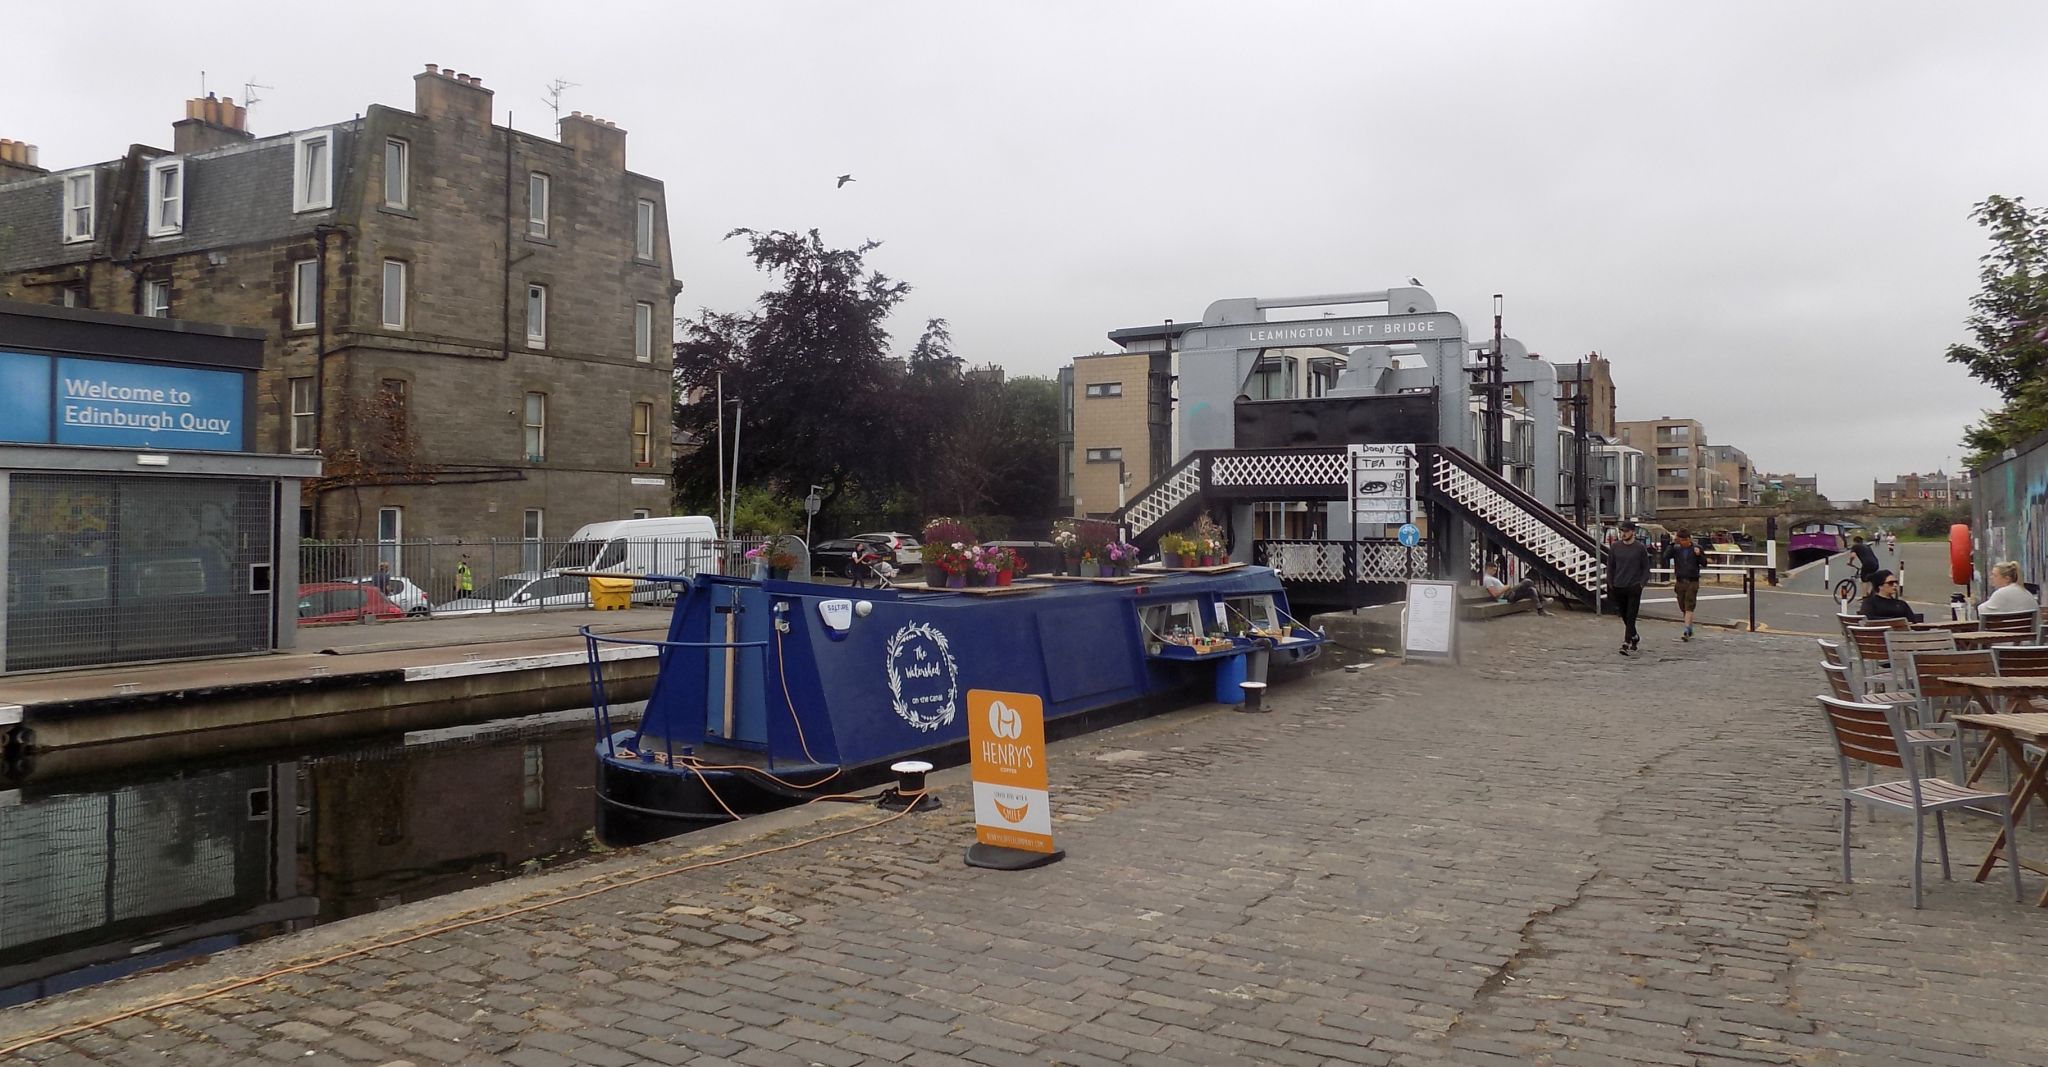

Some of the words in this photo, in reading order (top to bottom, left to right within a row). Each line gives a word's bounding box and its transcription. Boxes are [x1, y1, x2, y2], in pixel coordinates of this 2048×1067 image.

[1249, 327, 1333, 341] LEAMINGTON
[1343, 324, 1374, 336] LIFT
[1384, 321, 1435, 334] BRIDGE
[65, 378, 164, 403] Welcome
[169, 388, 191, 404] to
[65, 405, 173, 431] Edinburgh
[179, 412, 231, 435] Quay
[1362, 459, 1385, 468] TEA
[913, 645, 928, 660] The
[905, 662, 940, 679] Watershed
[982, 740, 1033, 768] HENRY'S
[1002, 808, 1021, 823] SMILE
